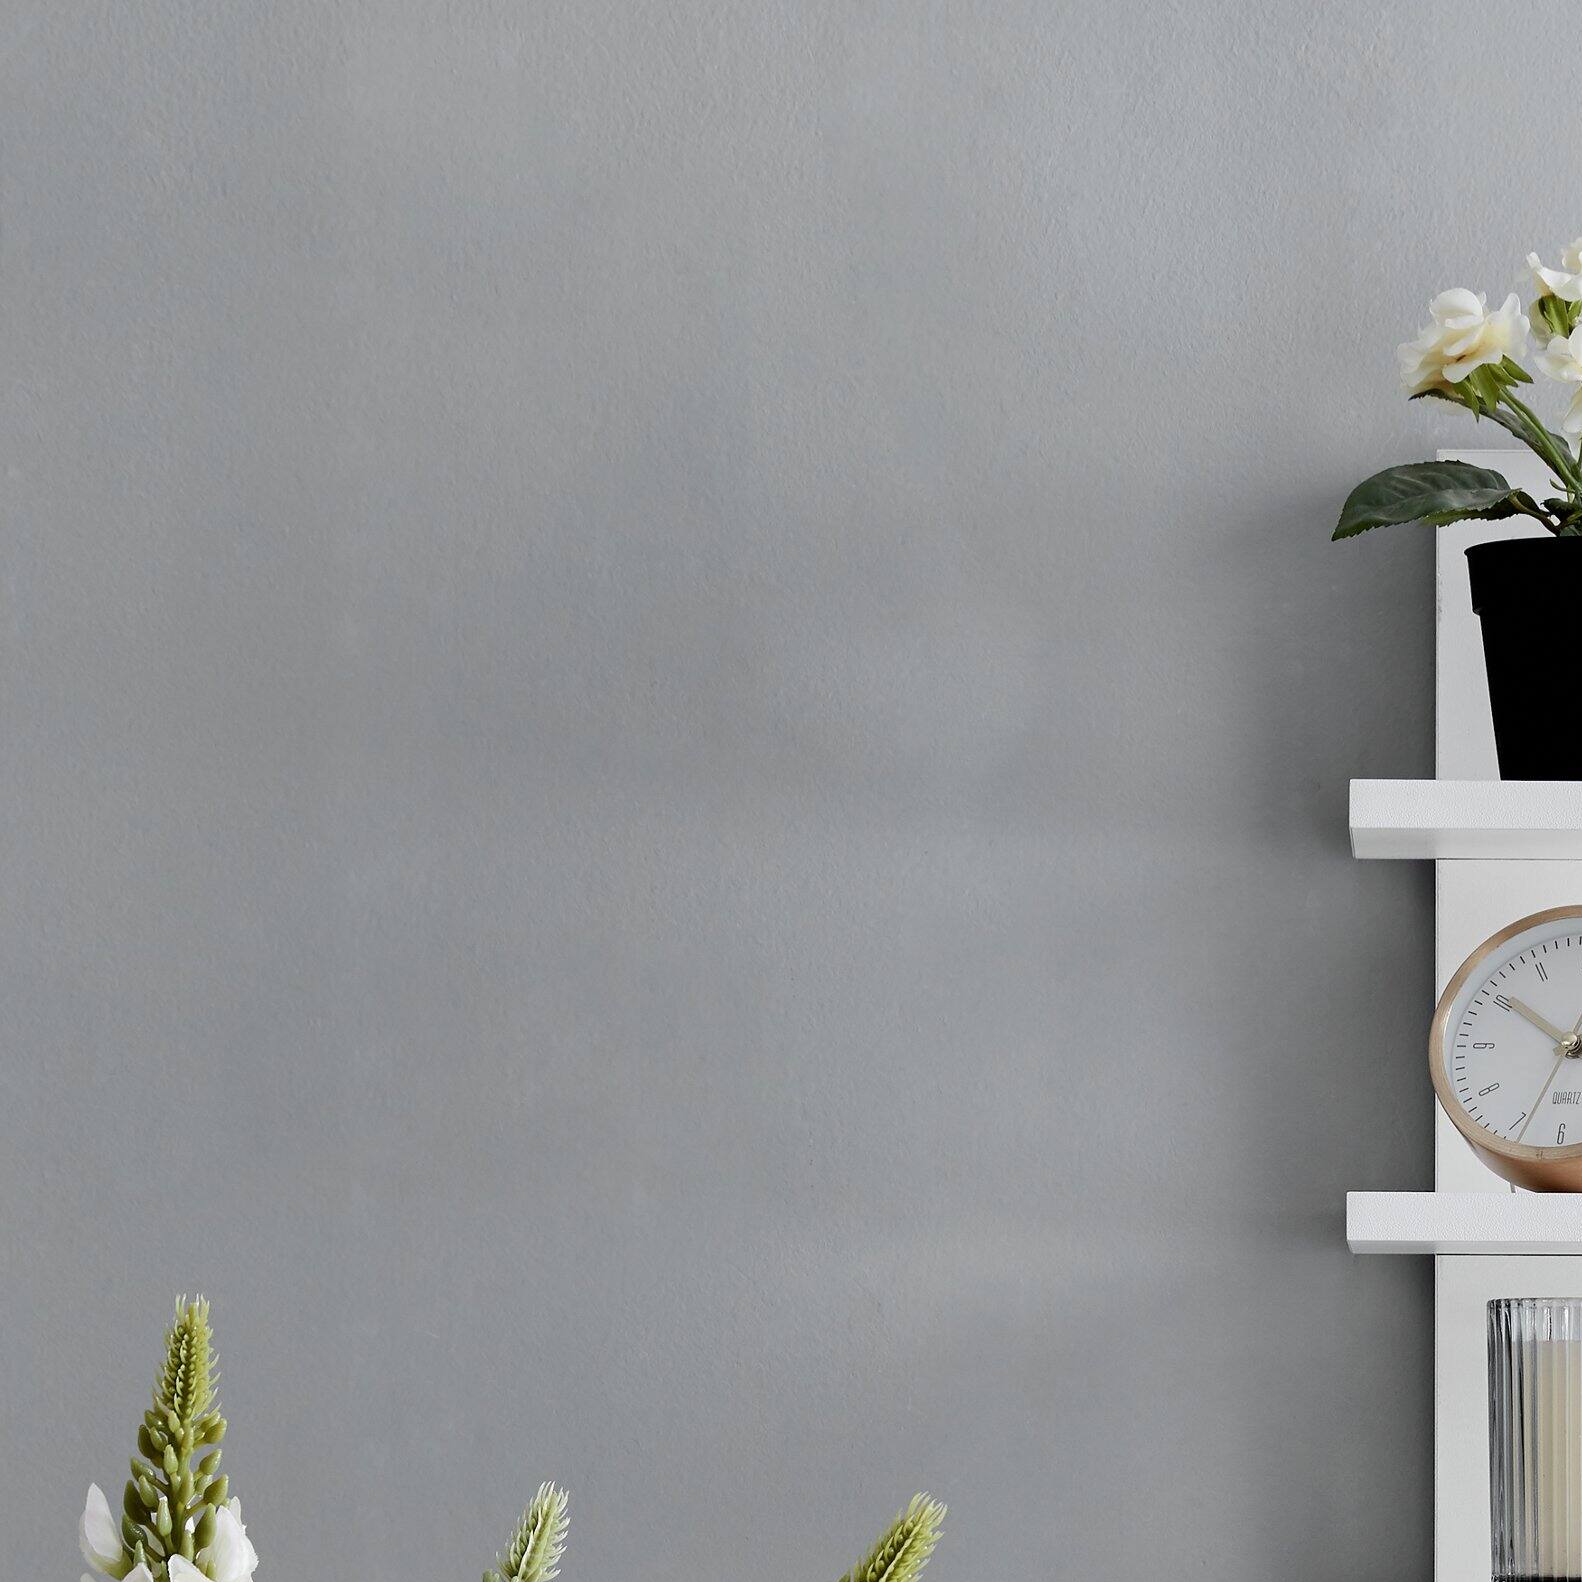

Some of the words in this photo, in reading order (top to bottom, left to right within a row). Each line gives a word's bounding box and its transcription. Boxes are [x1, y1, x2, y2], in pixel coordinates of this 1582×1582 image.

[1534, 961, 1549, 982] 11
[1493, 994, 1513, 1012] 10
[1473, 1042, 1495, 1050] 9
[1478, 1082, 1500, 1097] 8
[1552, 1091, 1582, 1105] QUARTZ
[1509, 1112, 1527, 1131] 7
[1556, 1123, 1566, 1145] 6
